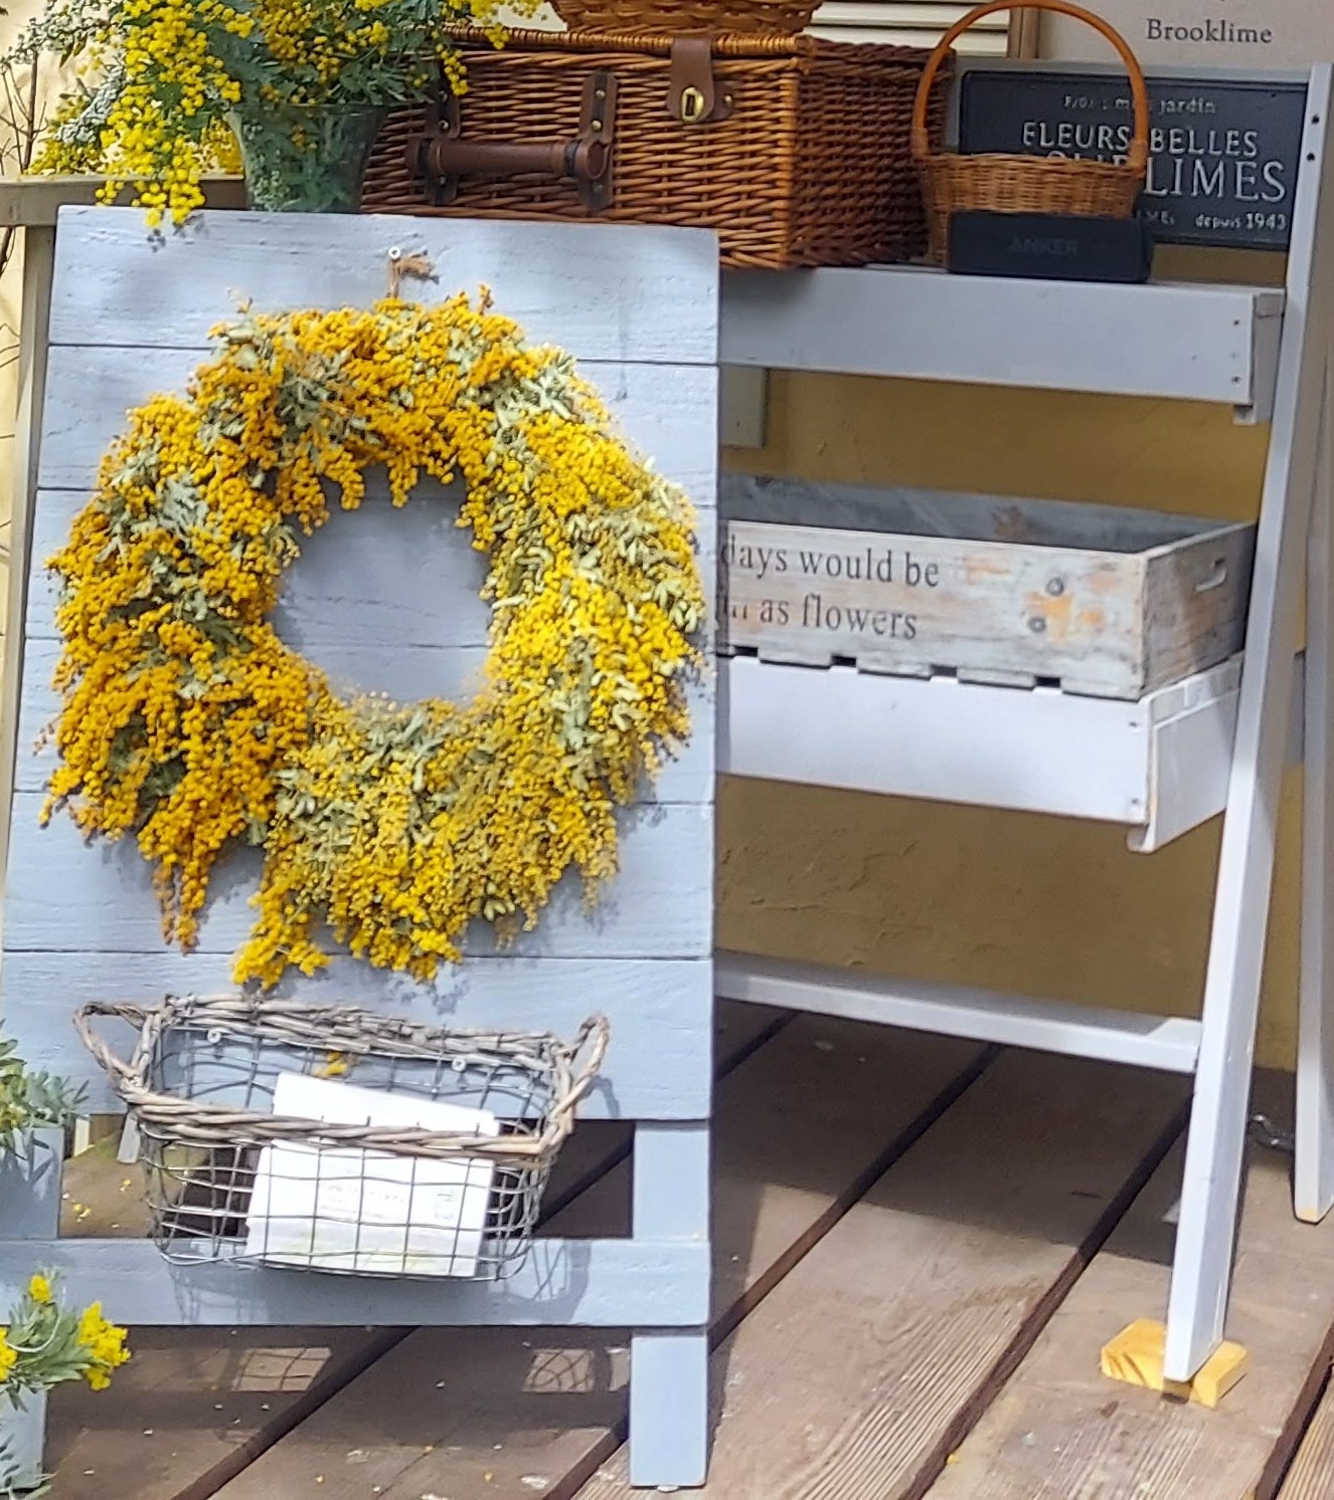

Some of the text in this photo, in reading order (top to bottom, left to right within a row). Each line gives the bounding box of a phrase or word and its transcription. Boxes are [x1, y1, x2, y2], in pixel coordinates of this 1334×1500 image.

[1146, 18, 1272, 44] Brooklime
[1023, 121, 1259, 159] FLEURS BELLES
[1008, 237, 1079, 255] ANKER
[800, 549, 893, 584] would
[905, 553, 939, 587] be
[760, 599, 790, 626] as
[802, 593, 918, 640] flowers
